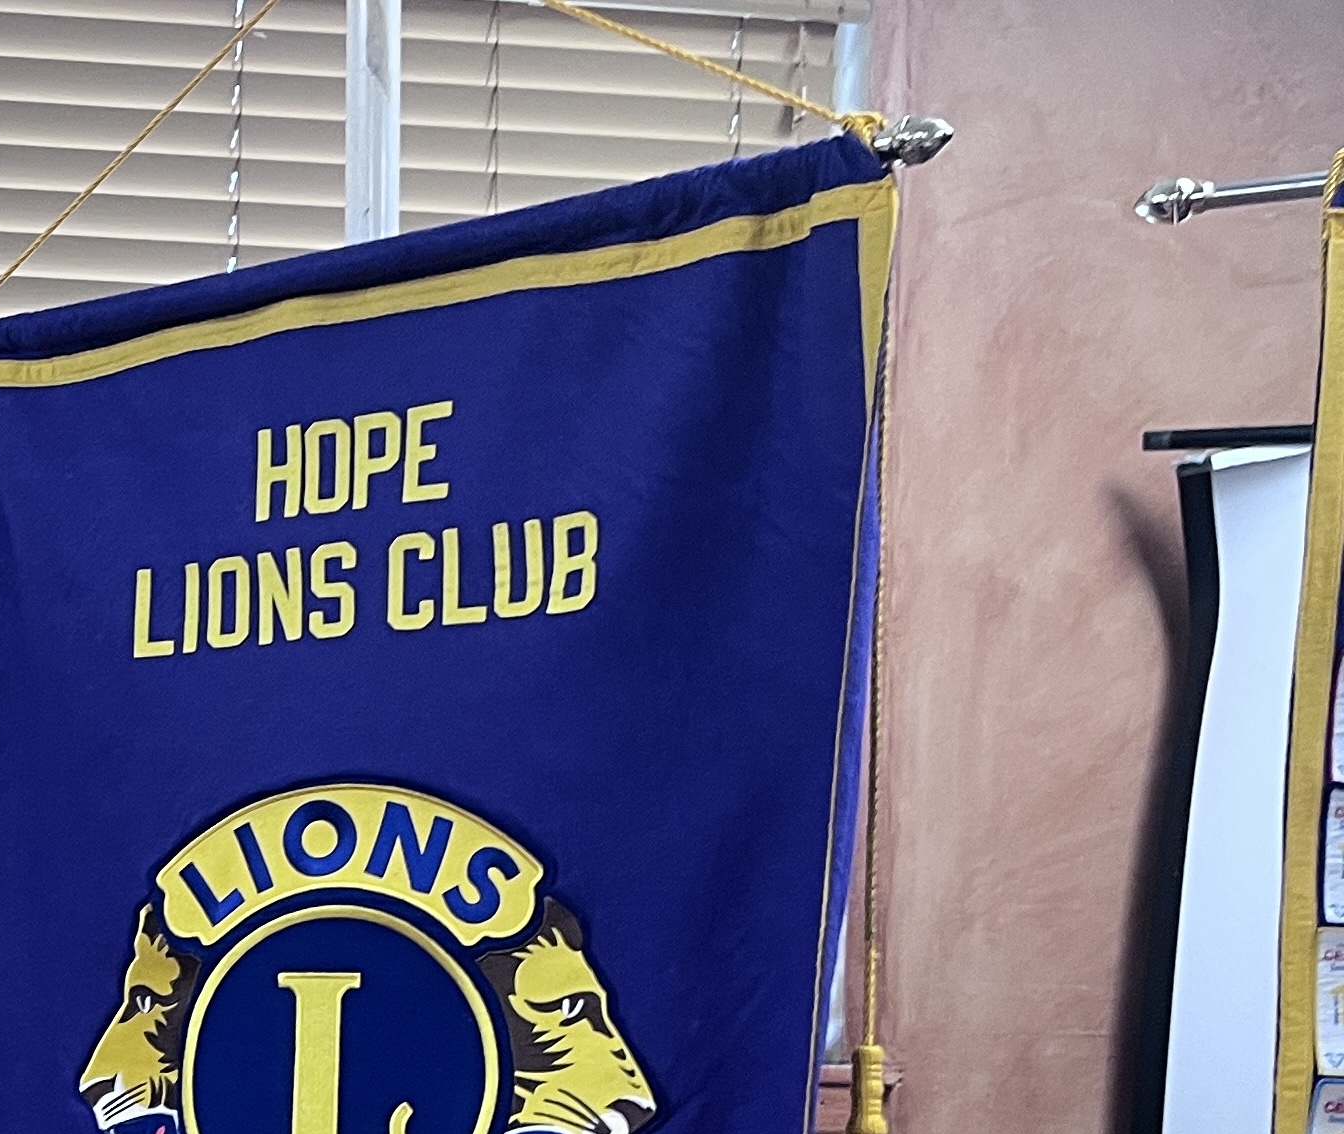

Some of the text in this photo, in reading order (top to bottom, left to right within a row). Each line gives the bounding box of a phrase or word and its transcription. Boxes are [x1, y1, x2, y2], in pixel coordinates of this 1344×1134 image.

[256, 400, 453, 522] HOPE
[133, 511, 598, 658] LIONS CLUB
[179, 800, 520, 926] LIONS
